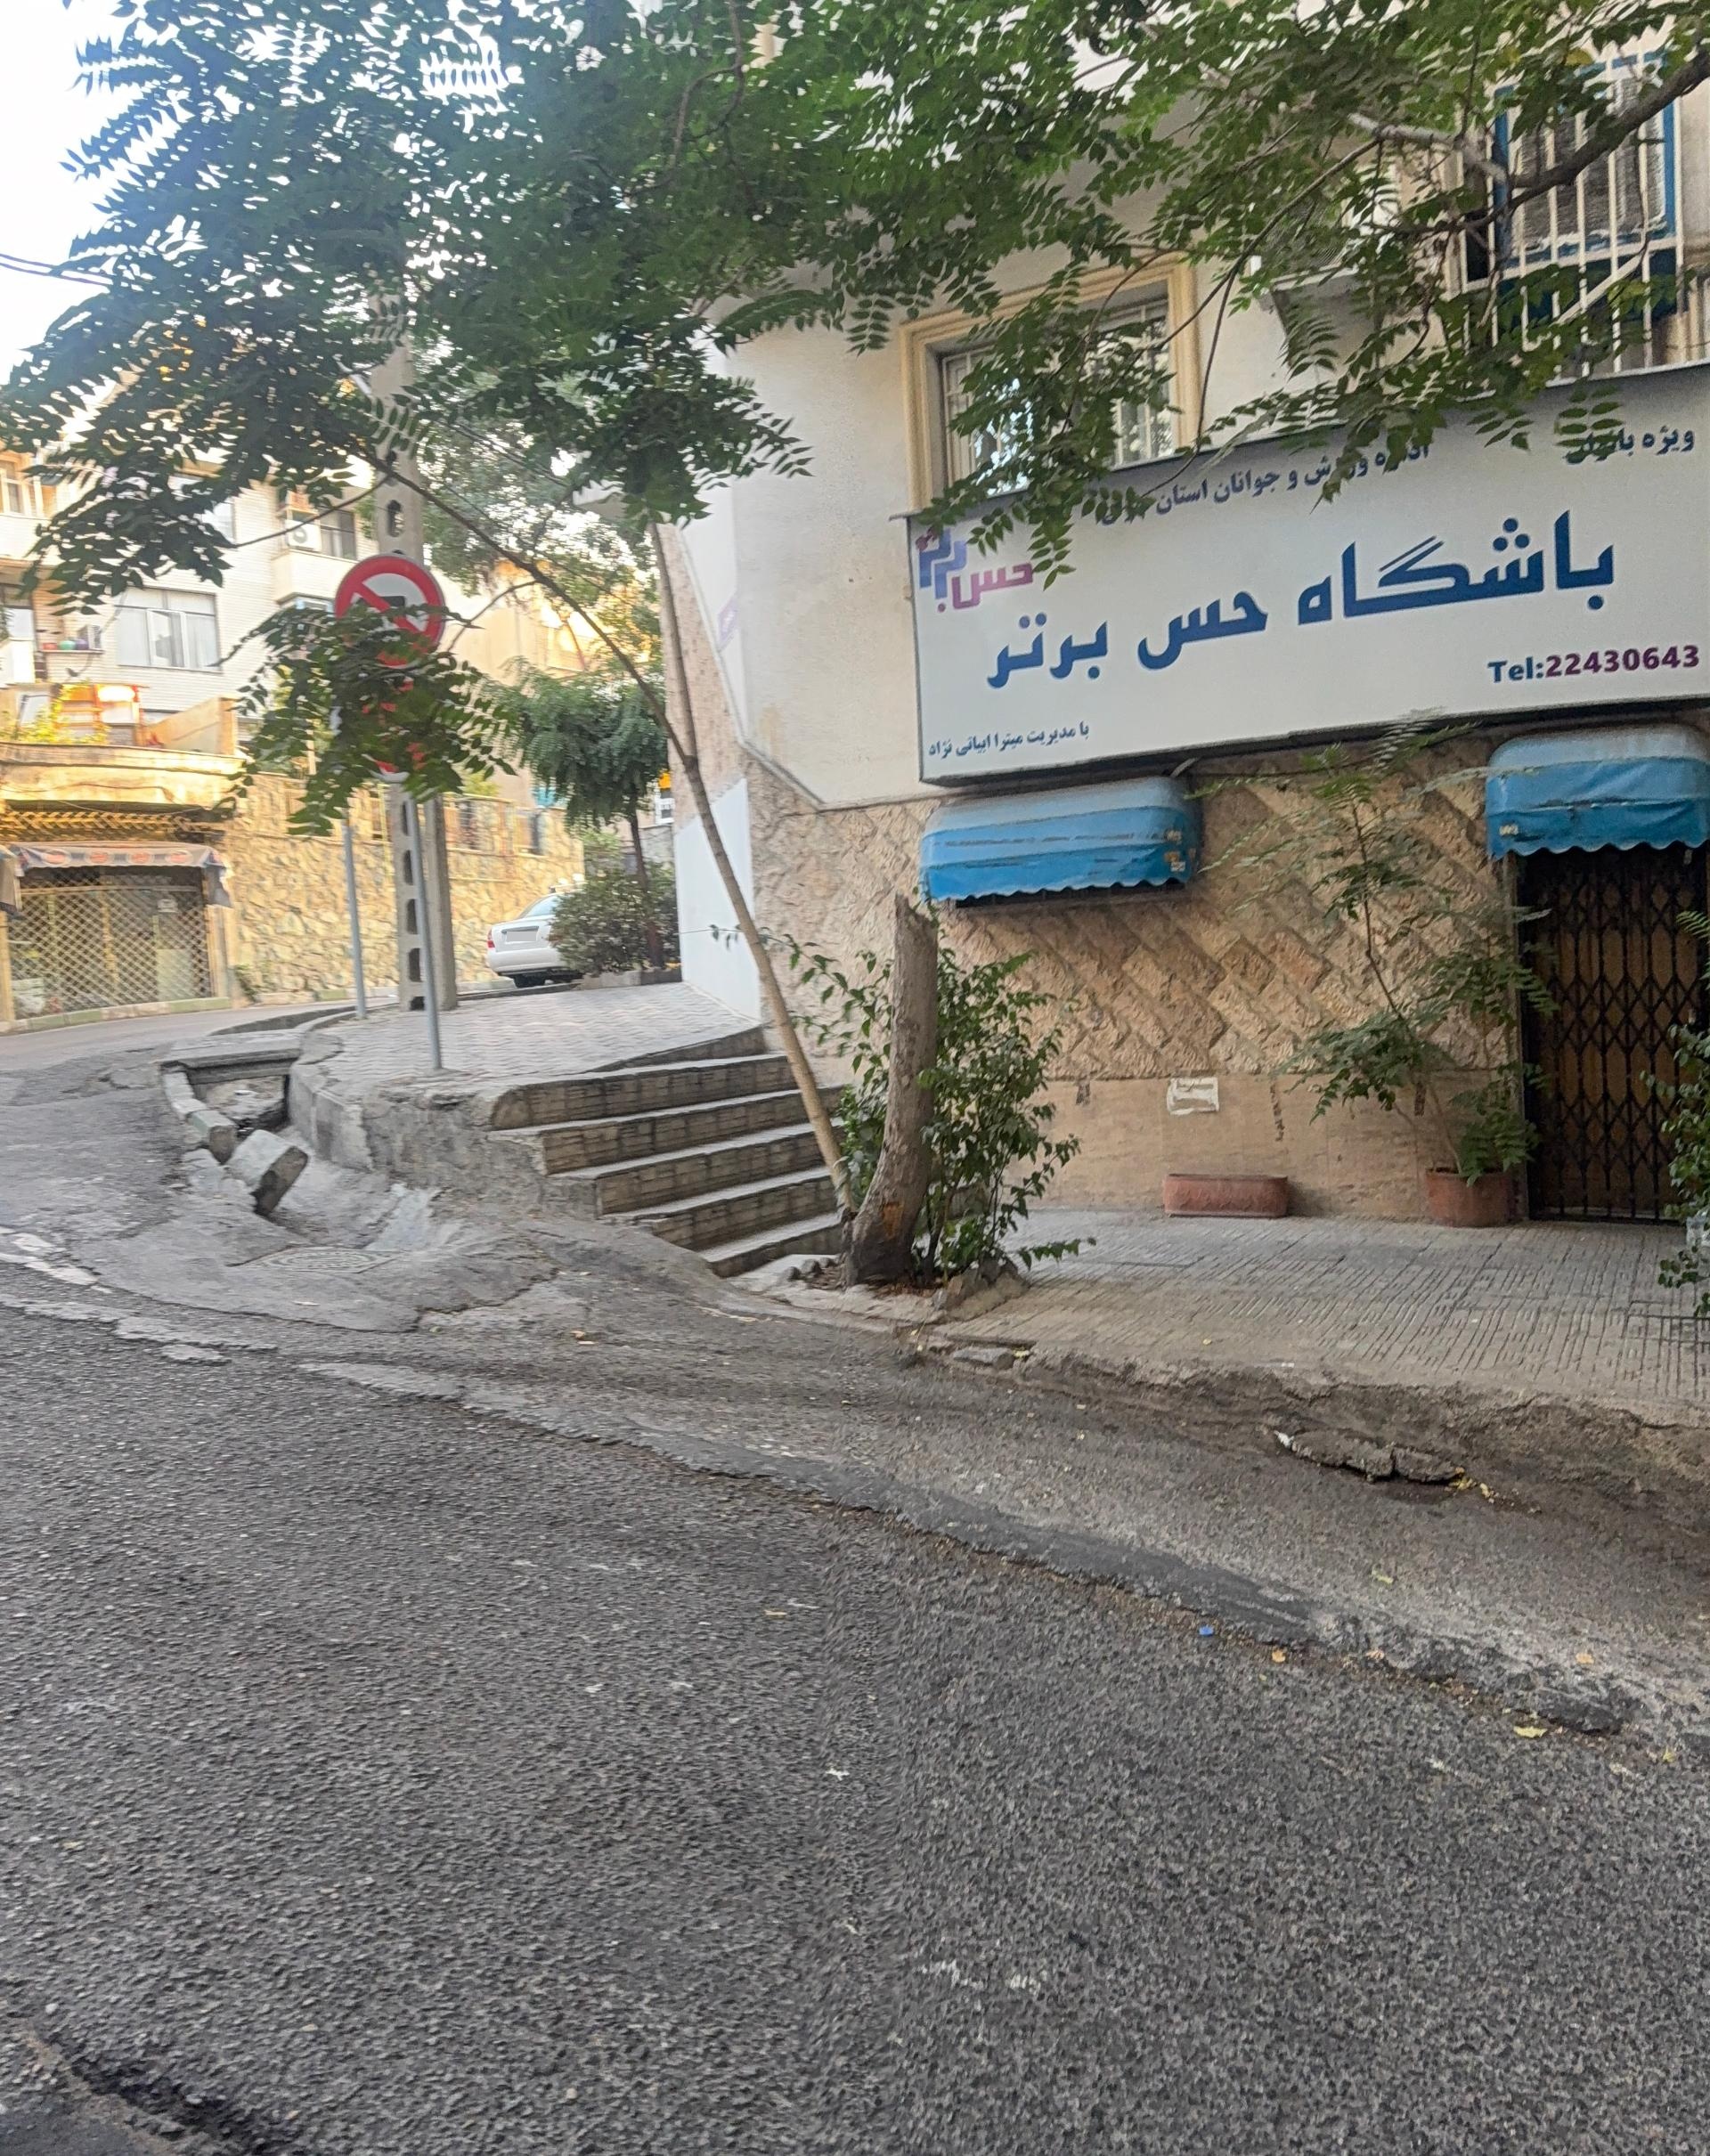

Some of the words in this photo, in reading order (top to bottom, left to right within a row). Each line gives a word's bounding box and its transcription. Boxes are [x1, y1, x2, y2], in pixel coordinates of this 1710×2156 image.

[1642, 425, 1695, 456] ویژه
[1156, 478, 1208, 515] استان
[1213, 469, 1281, 504] جوانان
[1287, 470, 1299, 491] و
[1298, 509, 1615, 625] باشگاه
[1137, 590, 1269, 670] حس
[987, 612, 1108, 688] برتر
[1487, 645, 1700, 682] Tel:22430643
[995, 732, 1023, 752] میترا
[1027, 726, 1076, 746] مدیریت
[1079, 720, 1090, 740] با
[929, 739, 953, 759] نژاد
